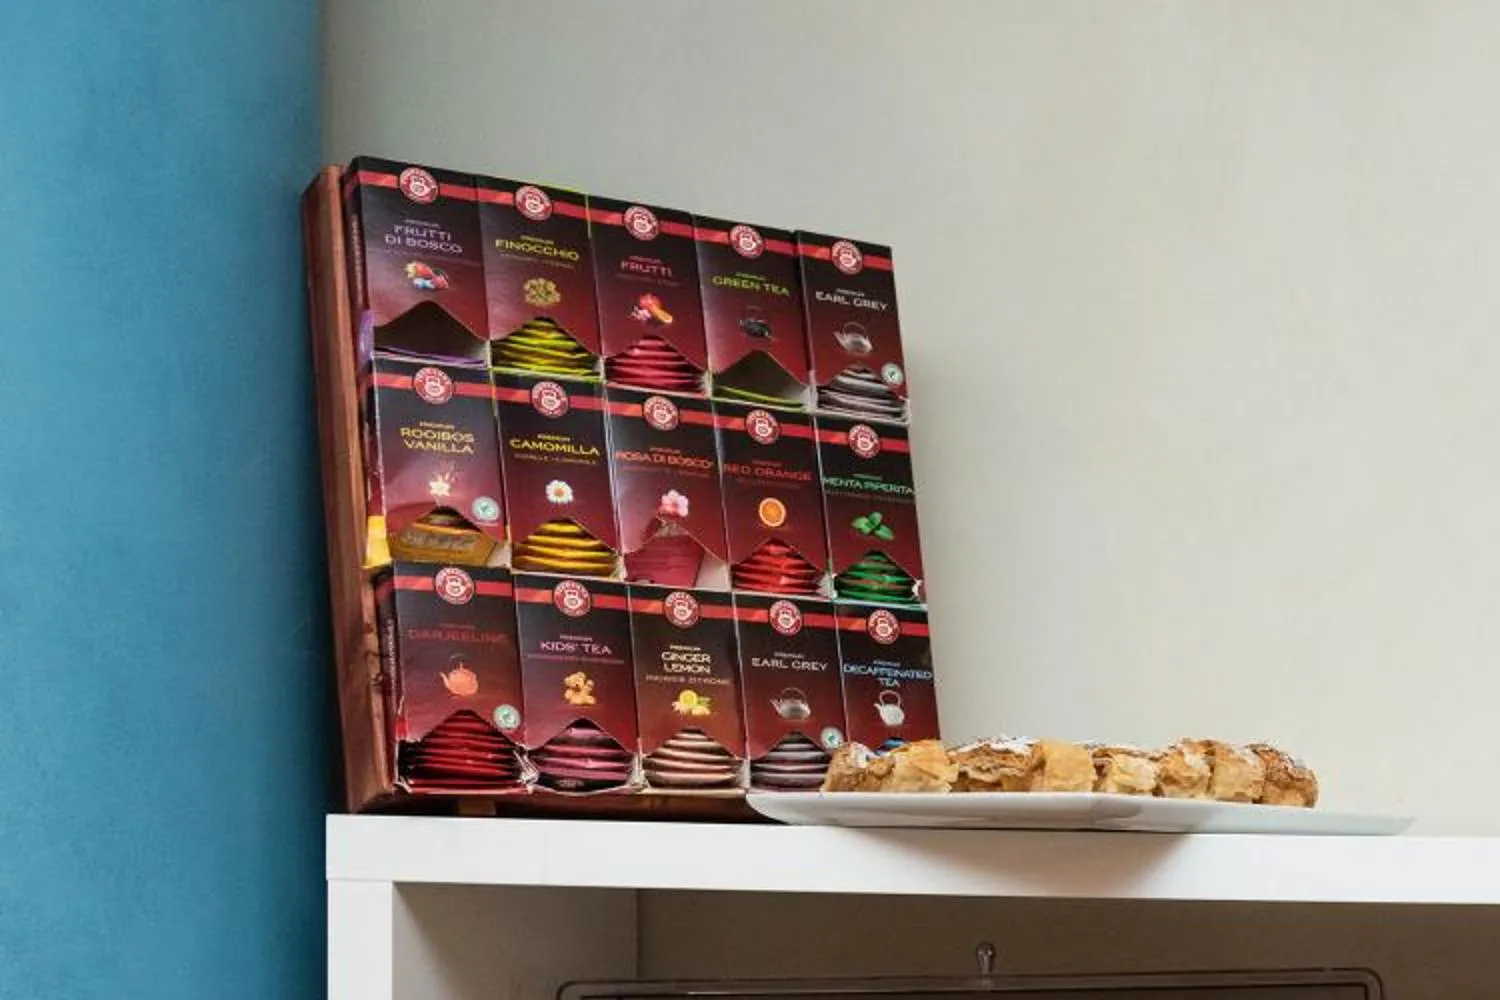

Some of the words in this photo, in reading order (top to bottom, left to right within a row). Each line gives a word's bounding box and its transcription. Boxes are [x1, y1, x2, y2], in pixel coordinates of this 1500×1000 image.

[393, 224, 452, 241] FRUTTI
[384, 233, 405, 246] DI
[406, 236, 463, 254] BOSCO
[495, 238, 581, 261] FINOCCHIO
[620, 260, 672, 278] FRUTTI
[711, 274, 761, 293] GREEN
[763, 282, 790, 297] TEA
[815, 290, 850, 306] EARL
[853, 295, 890, 312] GREY
[400, 426, 475, 443] ROOIBOS
[403, 438, 475, 454] VANILLA
[509, 439, 600, 456] CAMOMILLA
[408, 627, 509, 644] DARJEELING
[581, 643, 612, 655] TEA
[661, 651, 711, 663] GINGER
[663, 662, 711, 674] LEMON
[751, 657, 789, 669] EARL
[791, 660, 829, 672] GREY
